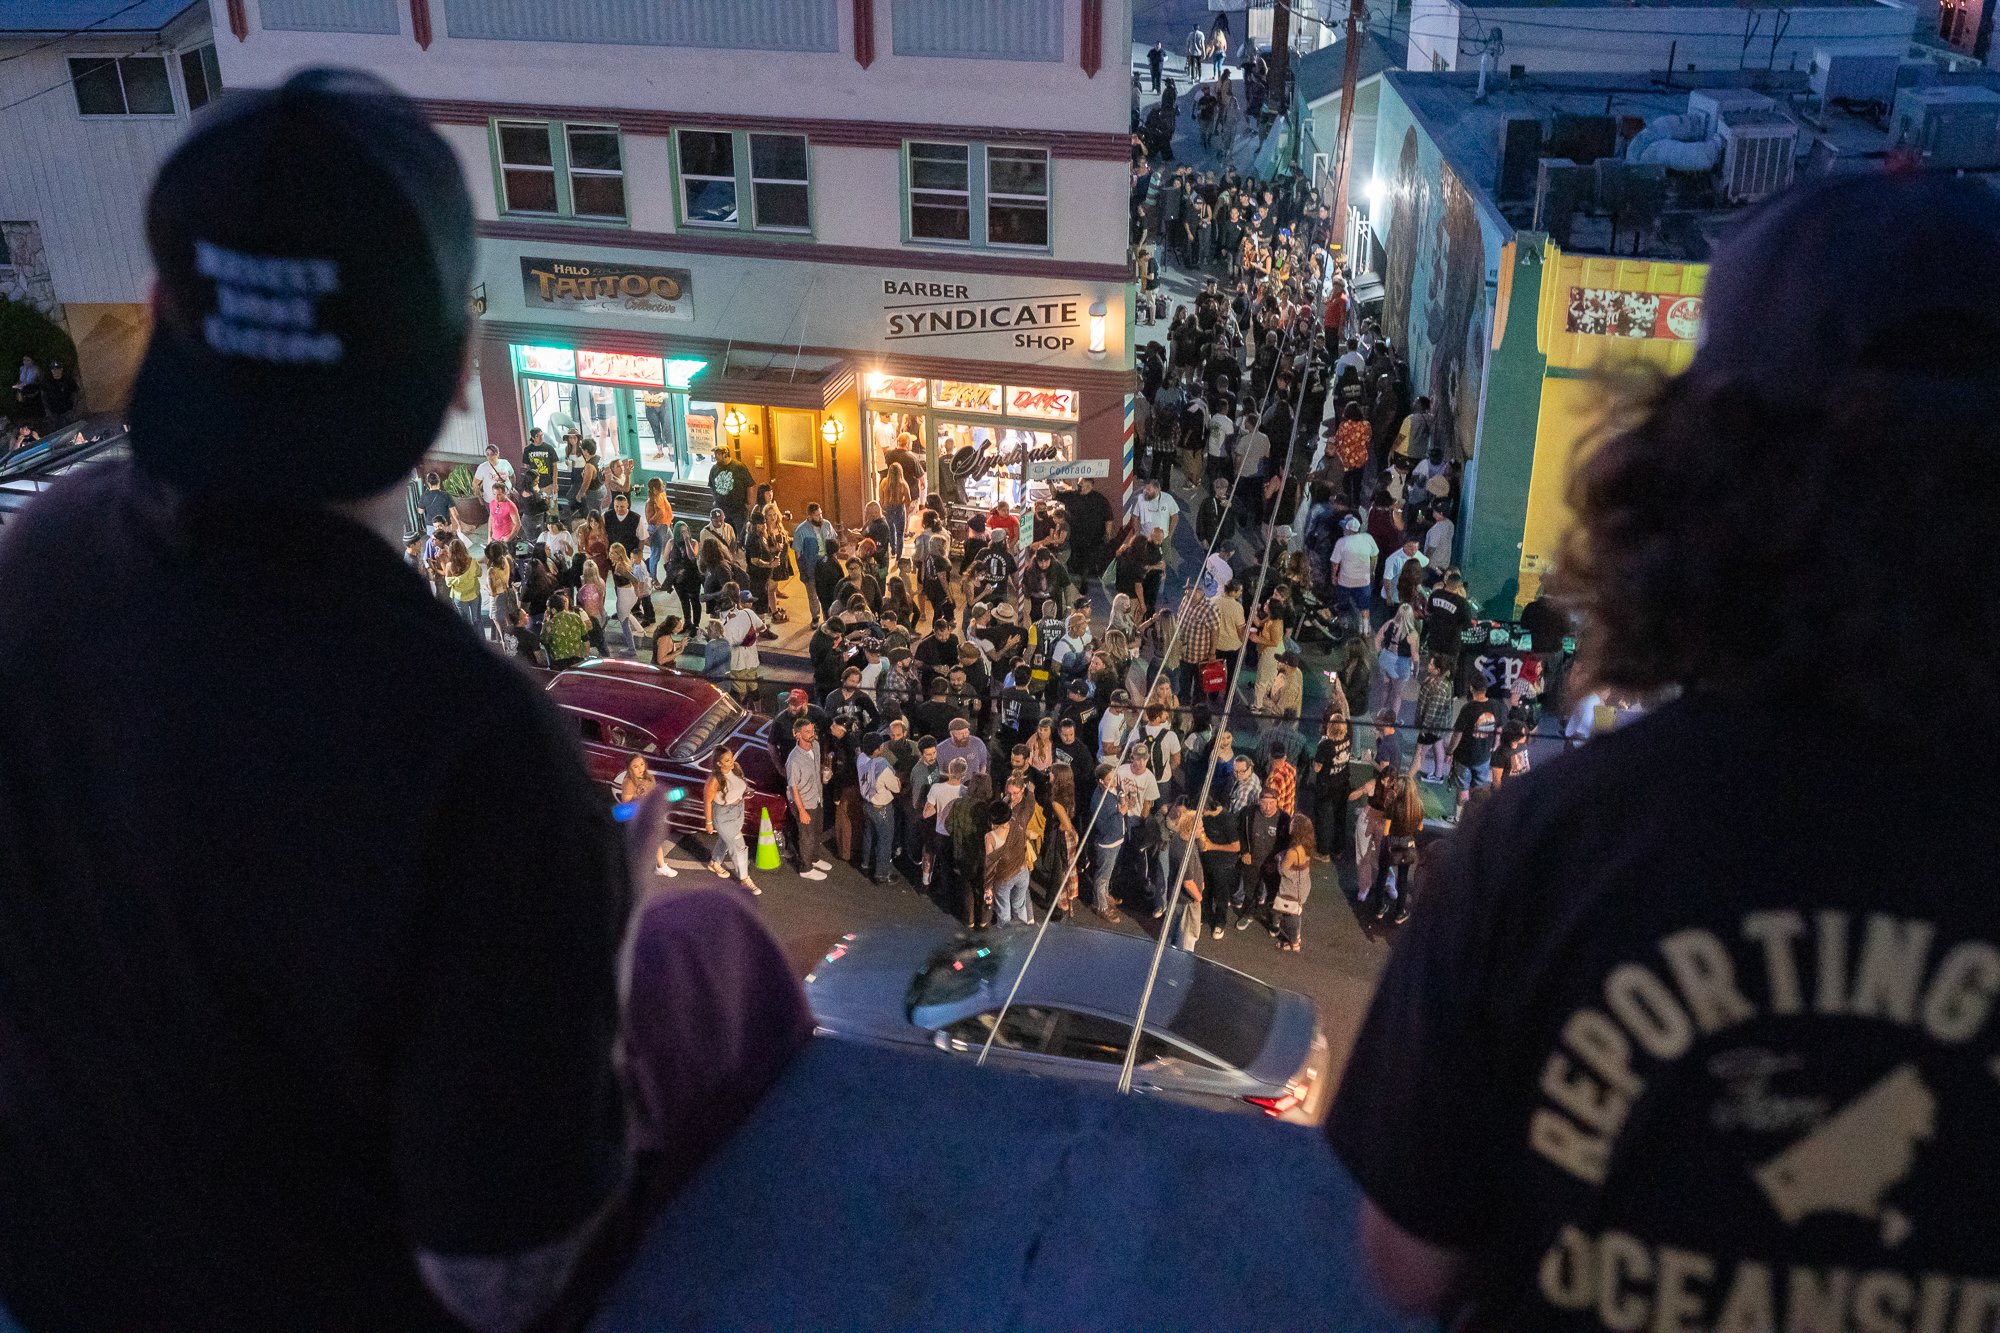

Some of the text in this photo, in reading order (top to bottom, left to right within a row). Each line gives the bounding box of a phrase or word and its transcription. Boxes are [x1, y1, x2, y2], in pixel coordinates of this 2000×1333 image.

[553, 264, 590, 276] HALO
[531, 269, 683, 302] TATTOO
[884, 280, 969, 299] BARBER
[624, 299, 676, 314] Collective
[889, 302, 1077, 335] SYNDICATE
[1014, 333, 1075, 350] SHOP
[1013, 391, 1069, 412] DAYS
[1049, 464, 1092, 476] Colorado
[1528, 909, 2000, 1185] REPORTING
